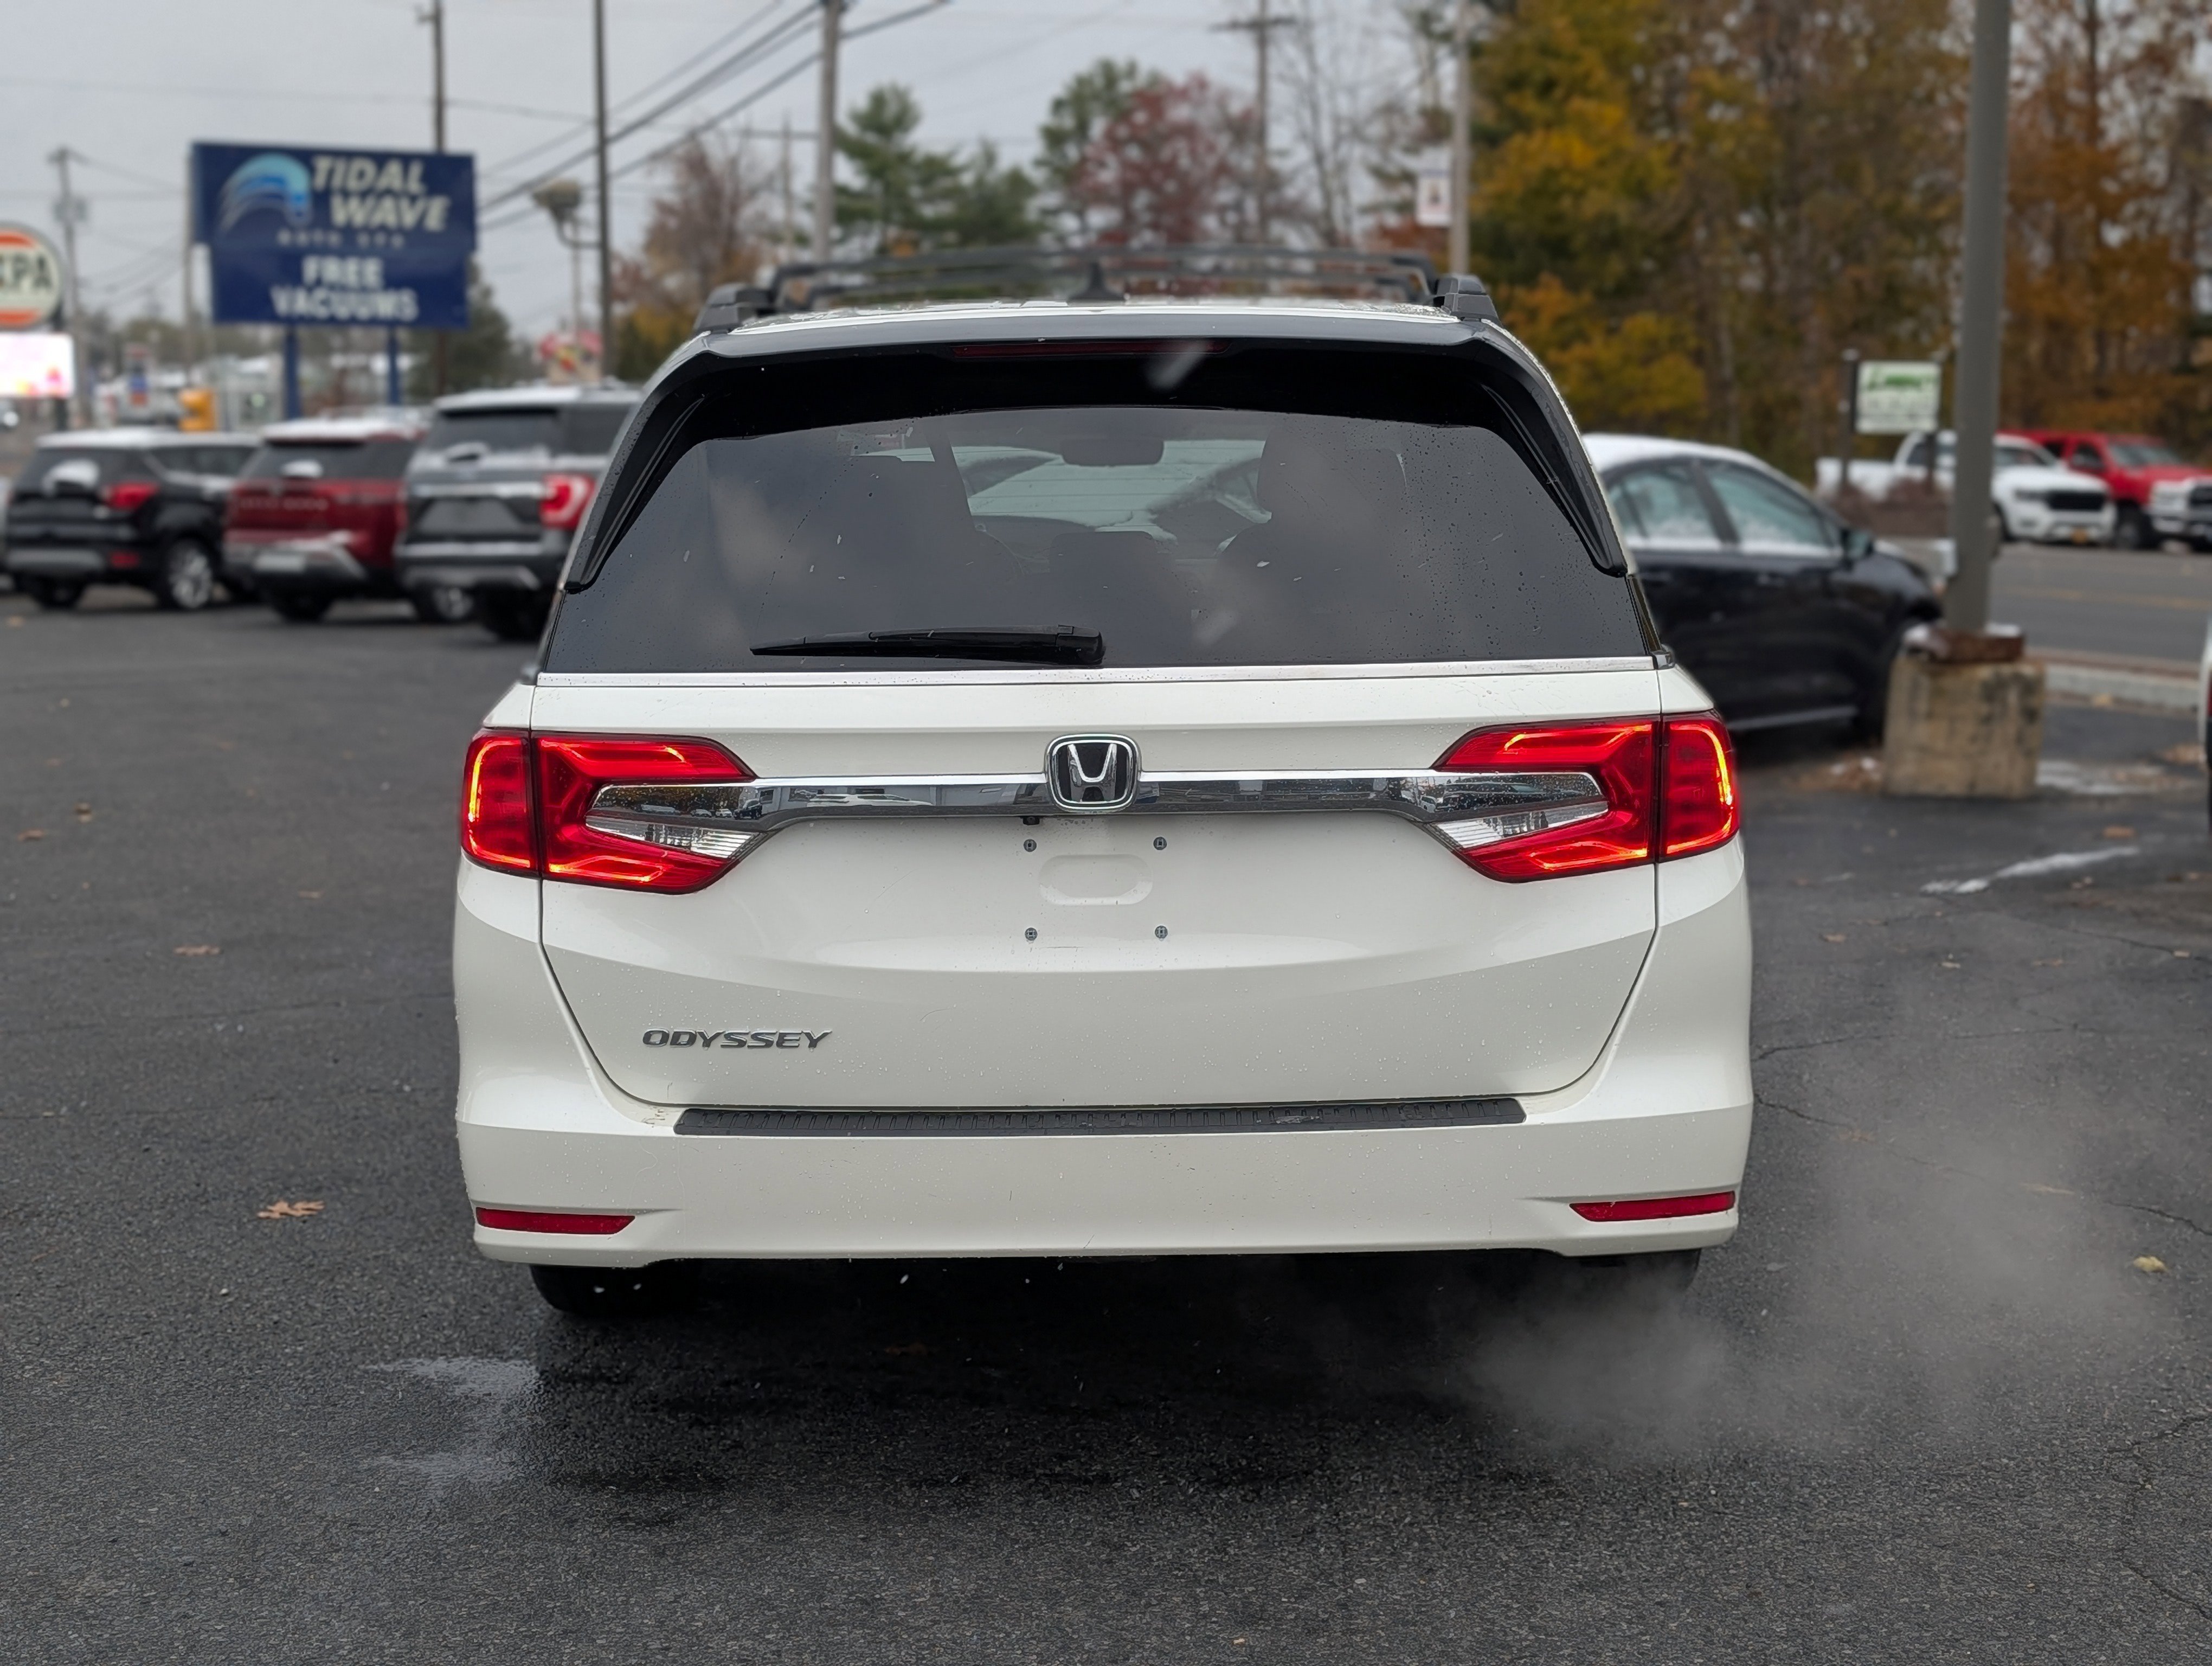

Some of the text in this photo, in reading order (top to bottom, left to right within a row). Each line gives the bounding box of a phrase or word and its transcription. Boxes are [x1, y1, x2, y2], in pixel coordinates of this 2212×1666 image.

[311, 156, 427, 195] TIDAL
[329, 195, 451, 231] WAVE
[301, 254, 384, 290] FREE
[270, 285, 420, 322] VACUUMS
[642, 1028, 833, 1048] ODYSSEY
